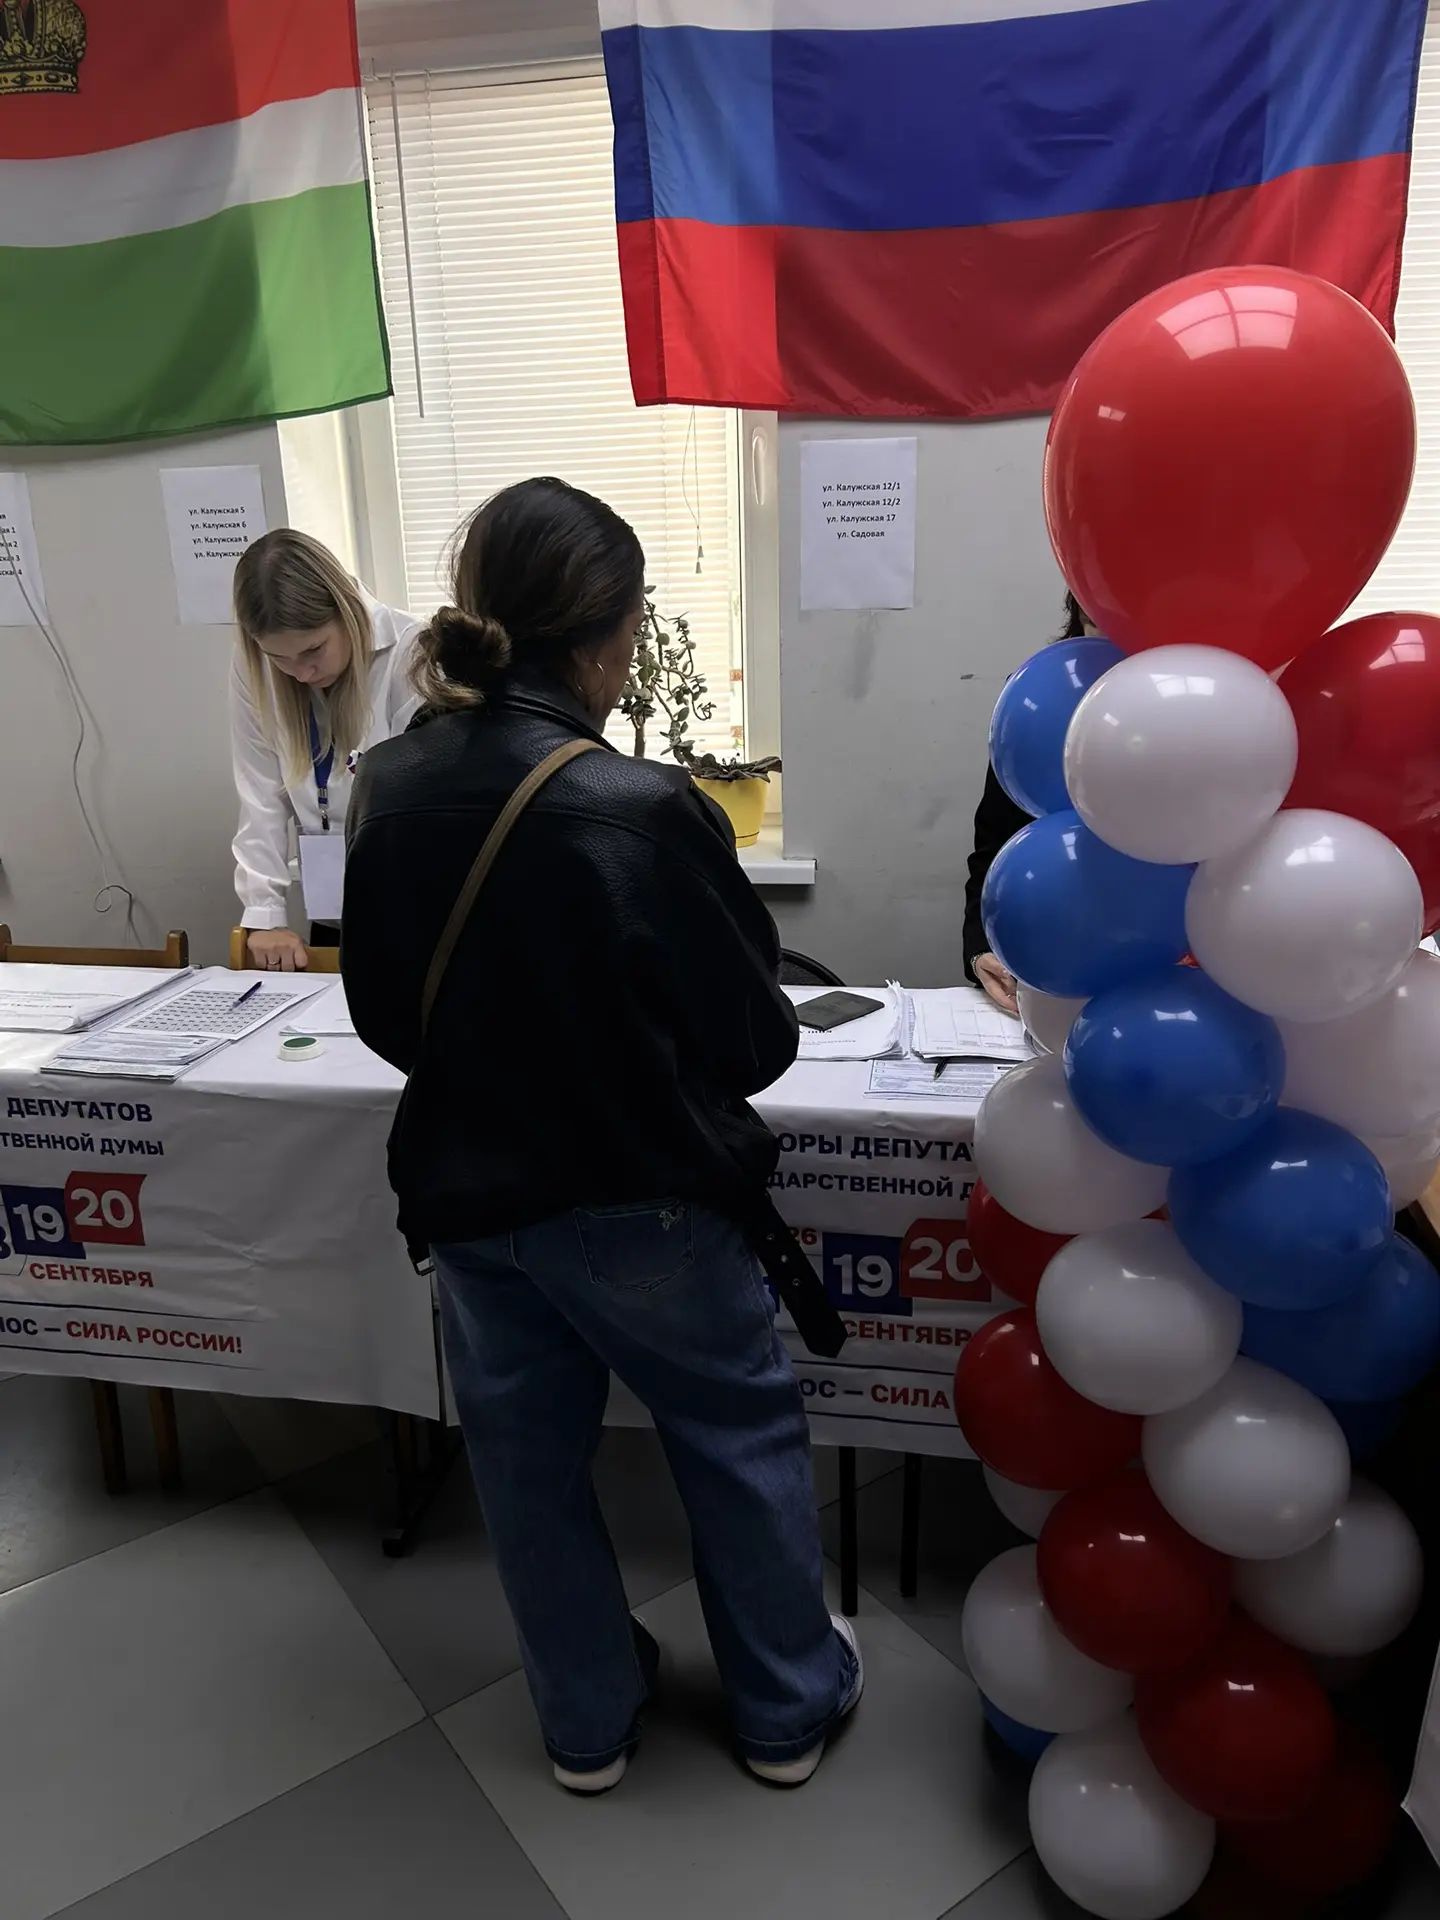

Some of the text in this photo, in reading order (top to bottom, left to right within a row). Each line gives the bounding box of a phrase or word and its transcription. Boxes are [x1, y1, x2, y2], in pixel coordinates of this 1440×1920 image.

[822, 482, 901, 492] ул. Калужская 12/1
[188, 508, 199, 516] ул.
[201, 507, 240, 516] Калужская
[822, 498, 901, 508] ул. Калужская 12/2
[190, 523, 201, 531] ул.
[202, 522, 241, 530] Калужская
[827, 514, 896, 524] ул. Калужская 17
[192, 537, 203, 545] ул.
[204, 536, 242, 544] Калужская
[837, 530, 885, 539] ул. Садовая
[7, 1097, 153, 1122] ДЕПУТАТОВ
[0, 1132, 165, 1156] ТВЕННОЙ ДУМЫ
[776, 1133, 974, 1162] ОРЫ ДЕПУТА
[767, 1171, 953, 1198] ДАРСТВЕННОЙ
[12, 1203, 66, 1243] 19
[70, 1188, 135, 1228] 20
[29, 1262, 154, 1288] СЕНТЯБРЯ
[832, 1253, 893, 1298] 19
[908, 1236, 982, 1283] 20
[66, 1320, 132, 1343] СИЛА
[137, 1326, 243, 1354] РОССИИ!
[843, 1319, 972, 1347] СЕНТЯБР
[870, 1384, 951, 1410] СИЛА
